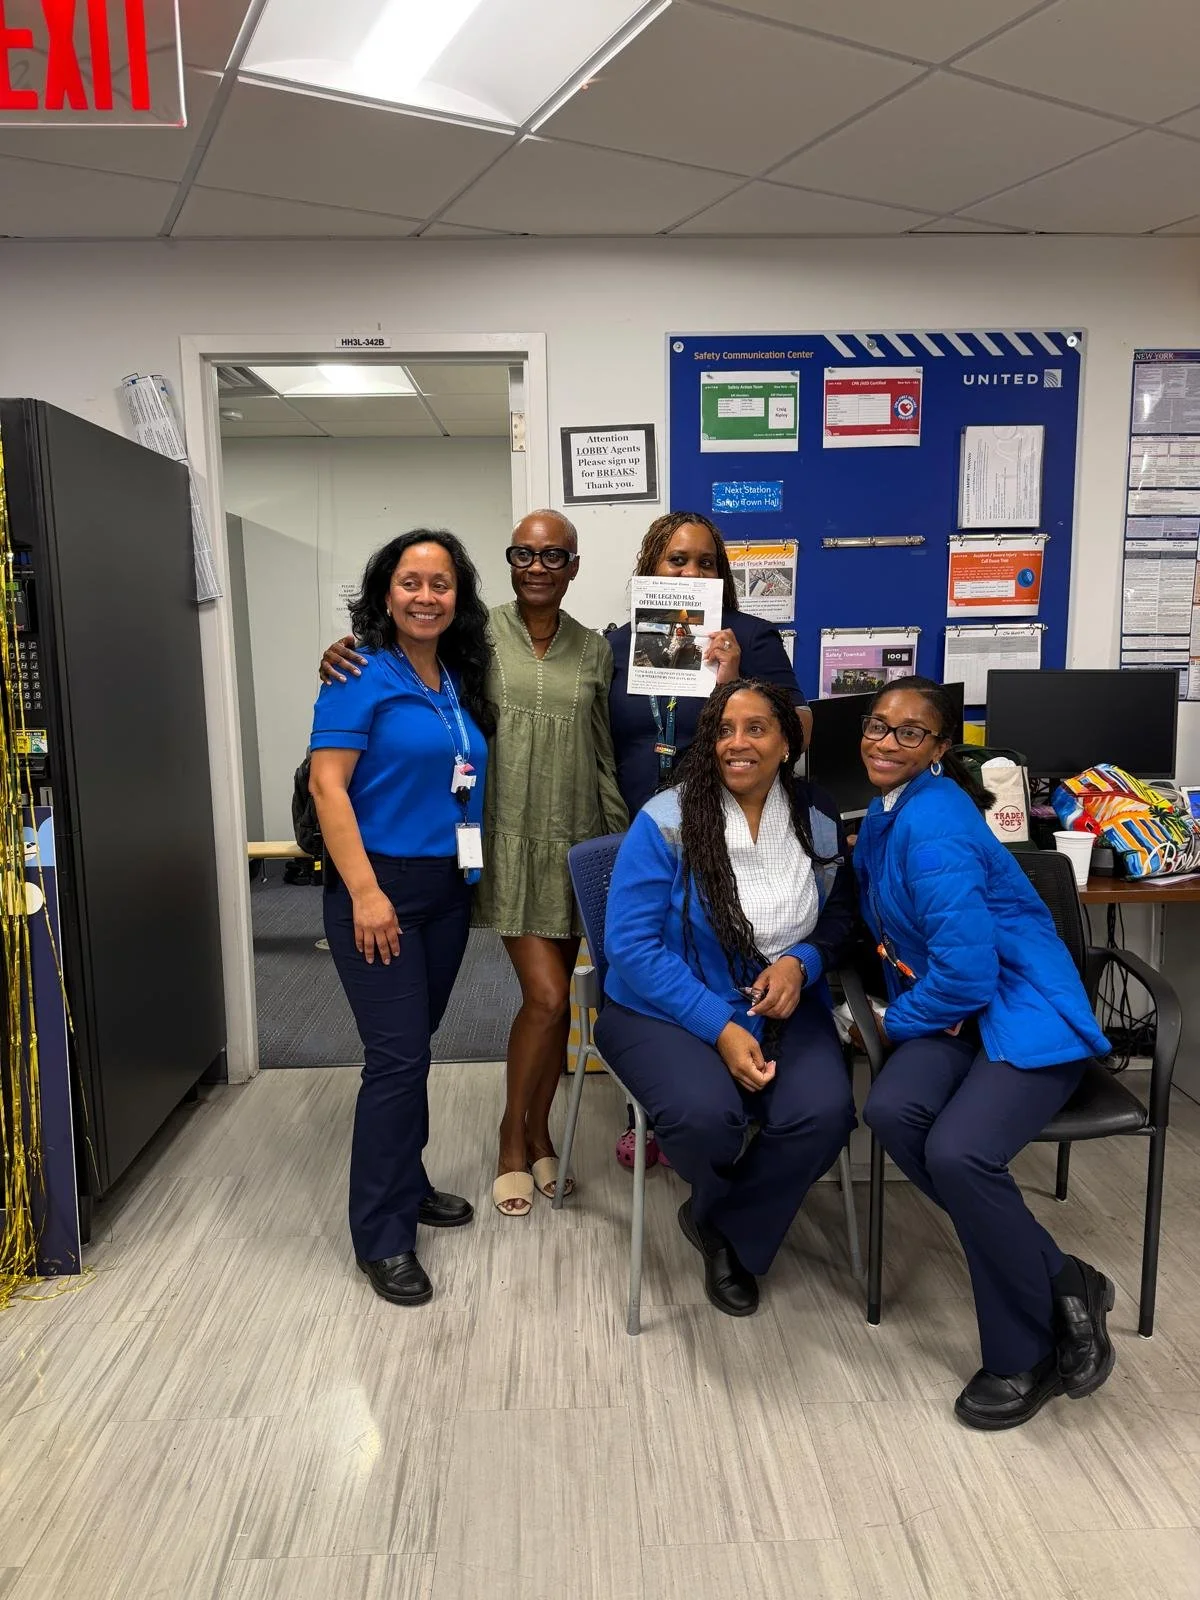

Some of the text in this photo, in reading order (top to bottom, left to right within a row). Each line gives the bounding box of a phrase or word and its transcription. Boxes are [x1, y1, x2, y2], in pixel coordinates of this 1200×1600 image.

[694, 351, 814, 360] Safety Communication Center
[1135, 352, 1152, 360] NEW
[963, 374, 1038, 385] UNITED
[587, 433, 629, 443] Attention
[576, 445, 640, 456] LOBBY Agents
[578, 459, 607, 467] Please
[608, 457, 626, 465] sign
[581, 468, 637, 478] for BREAKS.
[585, 481, 634, 490] Thank you.
[725, 485, 771, 494] Next Station
[994, 812, 1025, 820] TRADER
[1000, 819, 1022, 827] JOE'S
